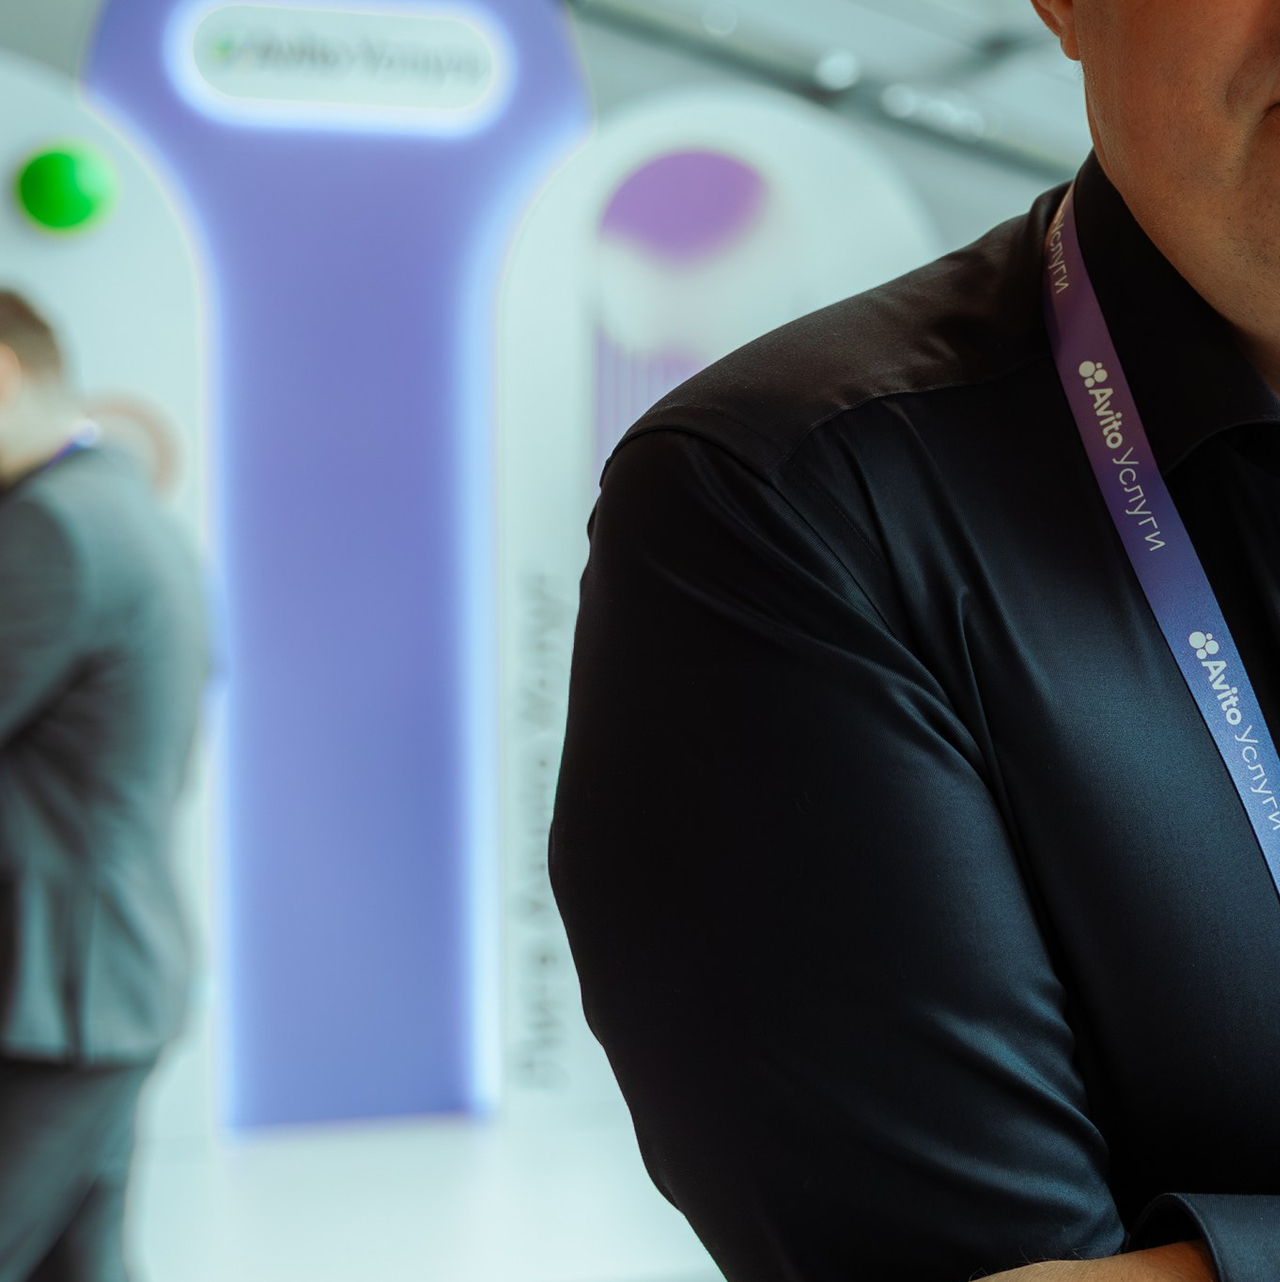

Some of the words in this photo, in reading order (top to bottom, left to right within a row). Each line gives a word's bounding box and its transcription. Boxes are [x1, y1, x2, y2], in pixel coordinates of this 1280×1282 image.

[1088, 387, 1123, 449] Avito
[1112, 447, 1166, 552] Услуги
[1201, 660, 1242, 725] Avito
